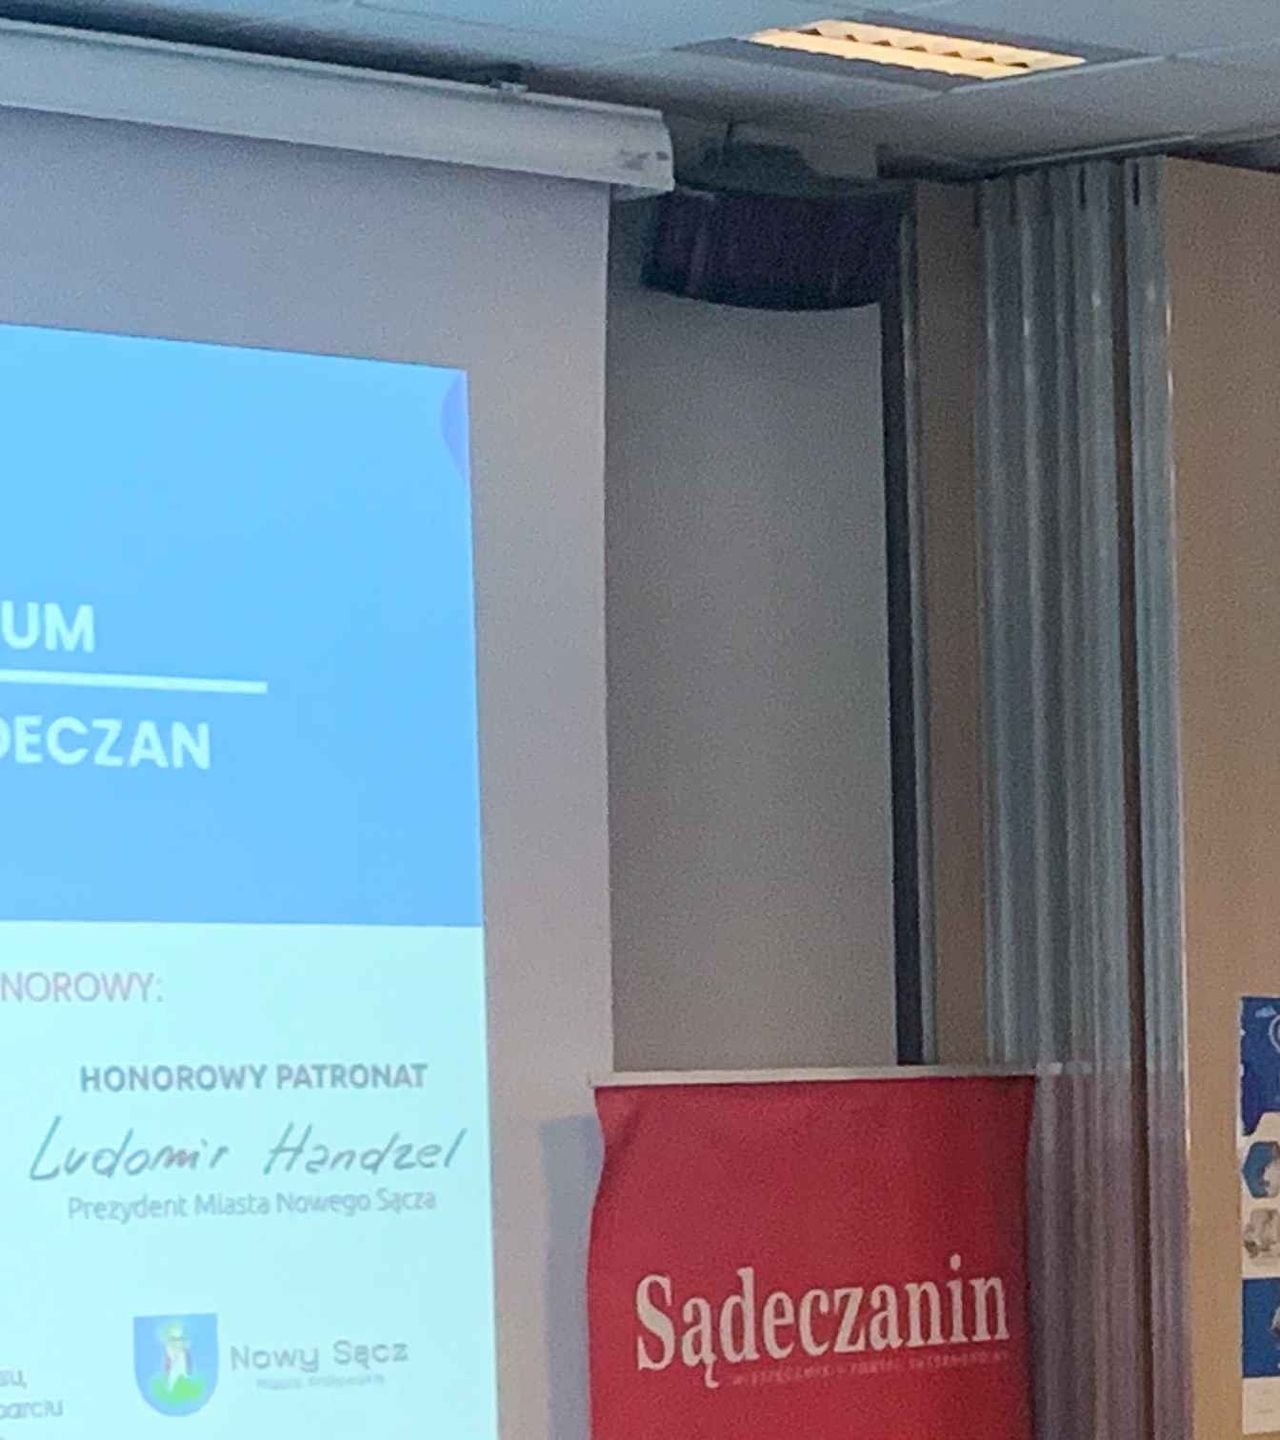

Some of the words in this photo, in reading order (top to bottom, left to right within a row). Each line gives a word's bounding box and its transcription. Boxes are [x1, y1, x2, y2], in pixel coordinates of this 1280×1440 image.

[0, 714, 212, 770] ECZAN
[80, 1065, 267, 1093] HONOROWY
[277, 1063, 428, 1091] PATRONAT
[29, 1115, 230, 1182] Ludomir
[263, 1121, 468, 1177] Handzel
[68, 1195, 187, 1226] Prezydent
[194, 1192, 271, 1218] Miasta
[277, 1190, 372, 1218] Nowego
[377, 1186, 438, 1215] Sącza
[636, 1254, 1011, 1388] Sądeczanin
[230, 1344, 319, 1373] Nowy
[333, 1339, 409, 1369] Sącz
